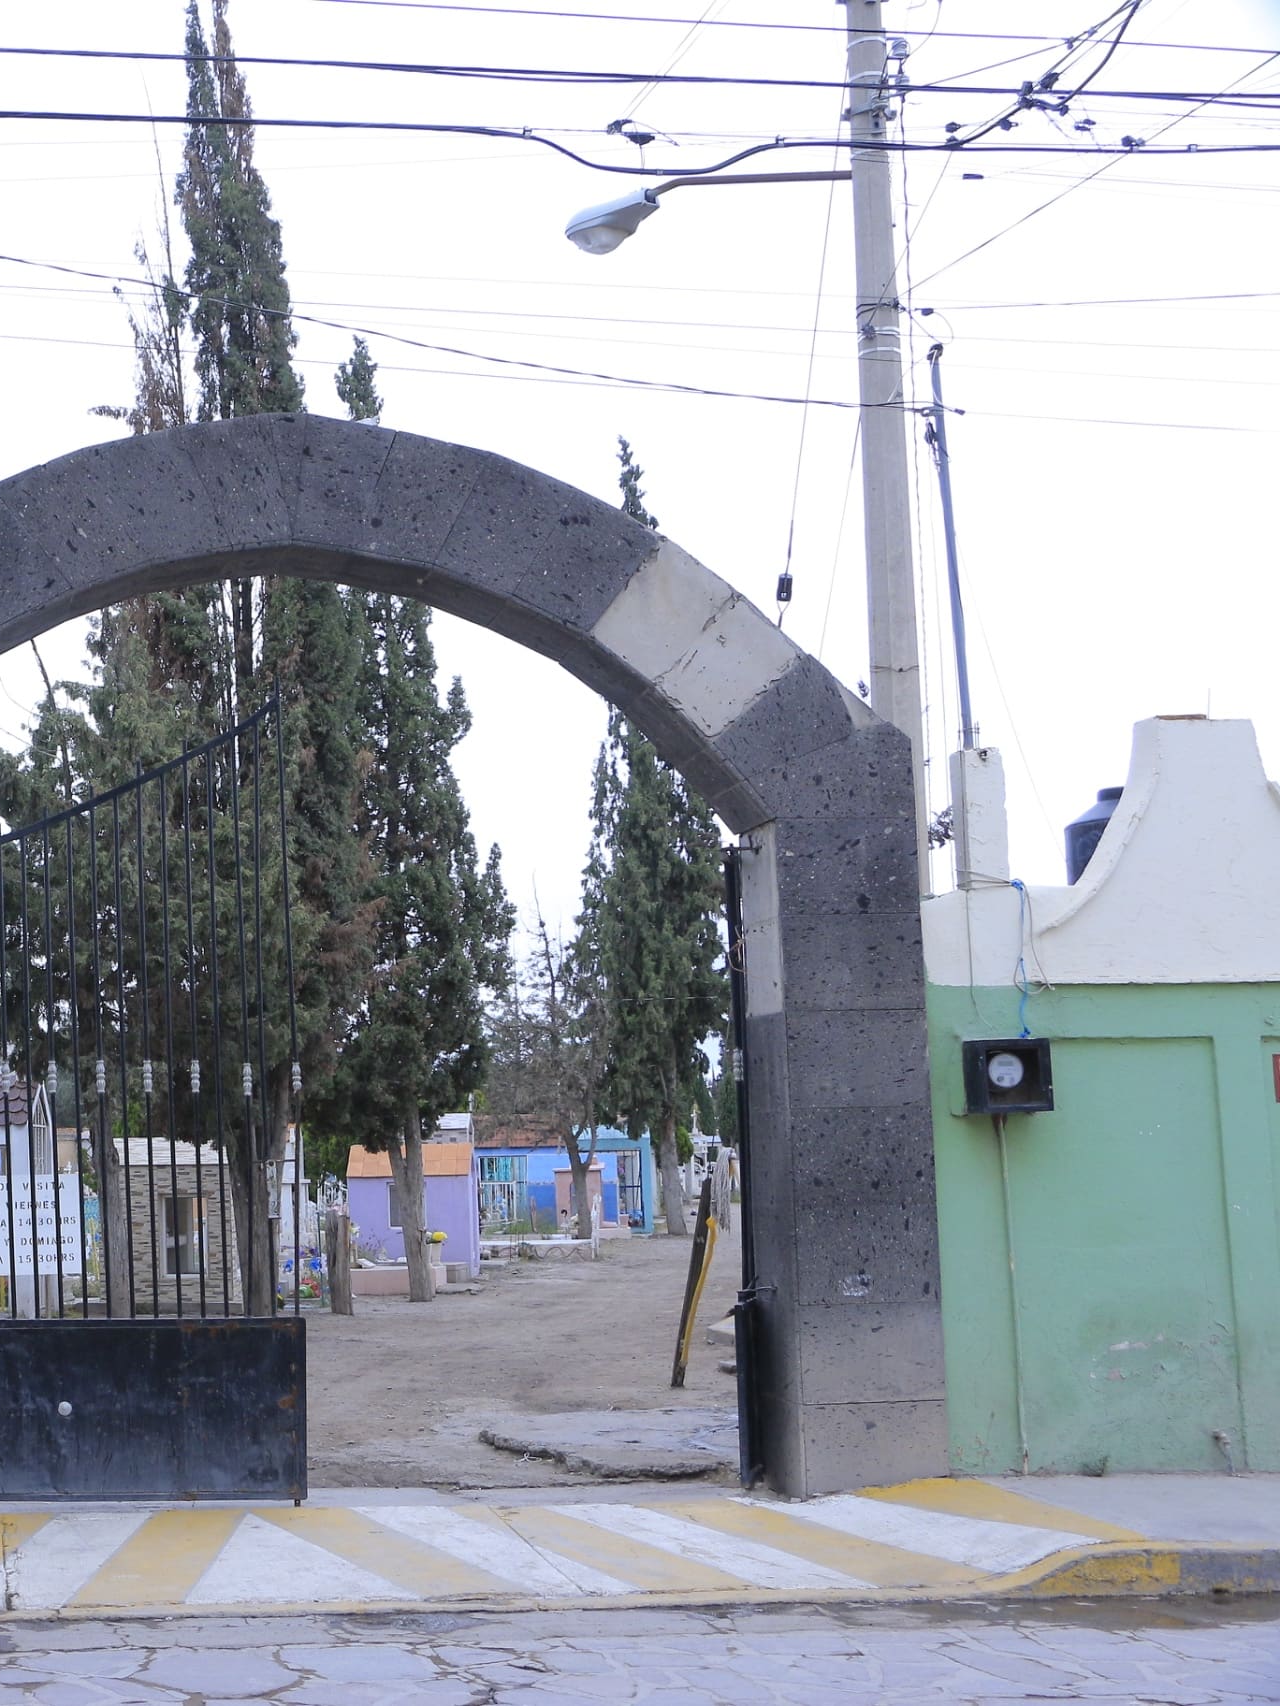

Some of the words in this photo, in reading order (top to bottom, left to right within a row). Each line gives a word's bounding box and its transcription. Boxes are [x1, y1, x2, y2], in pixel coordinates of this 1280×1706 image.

[22, 1181, 65, 1191] VSITA
[0, 1219, 7, 1228] A
[4, 1238, 10, 1247] Y
